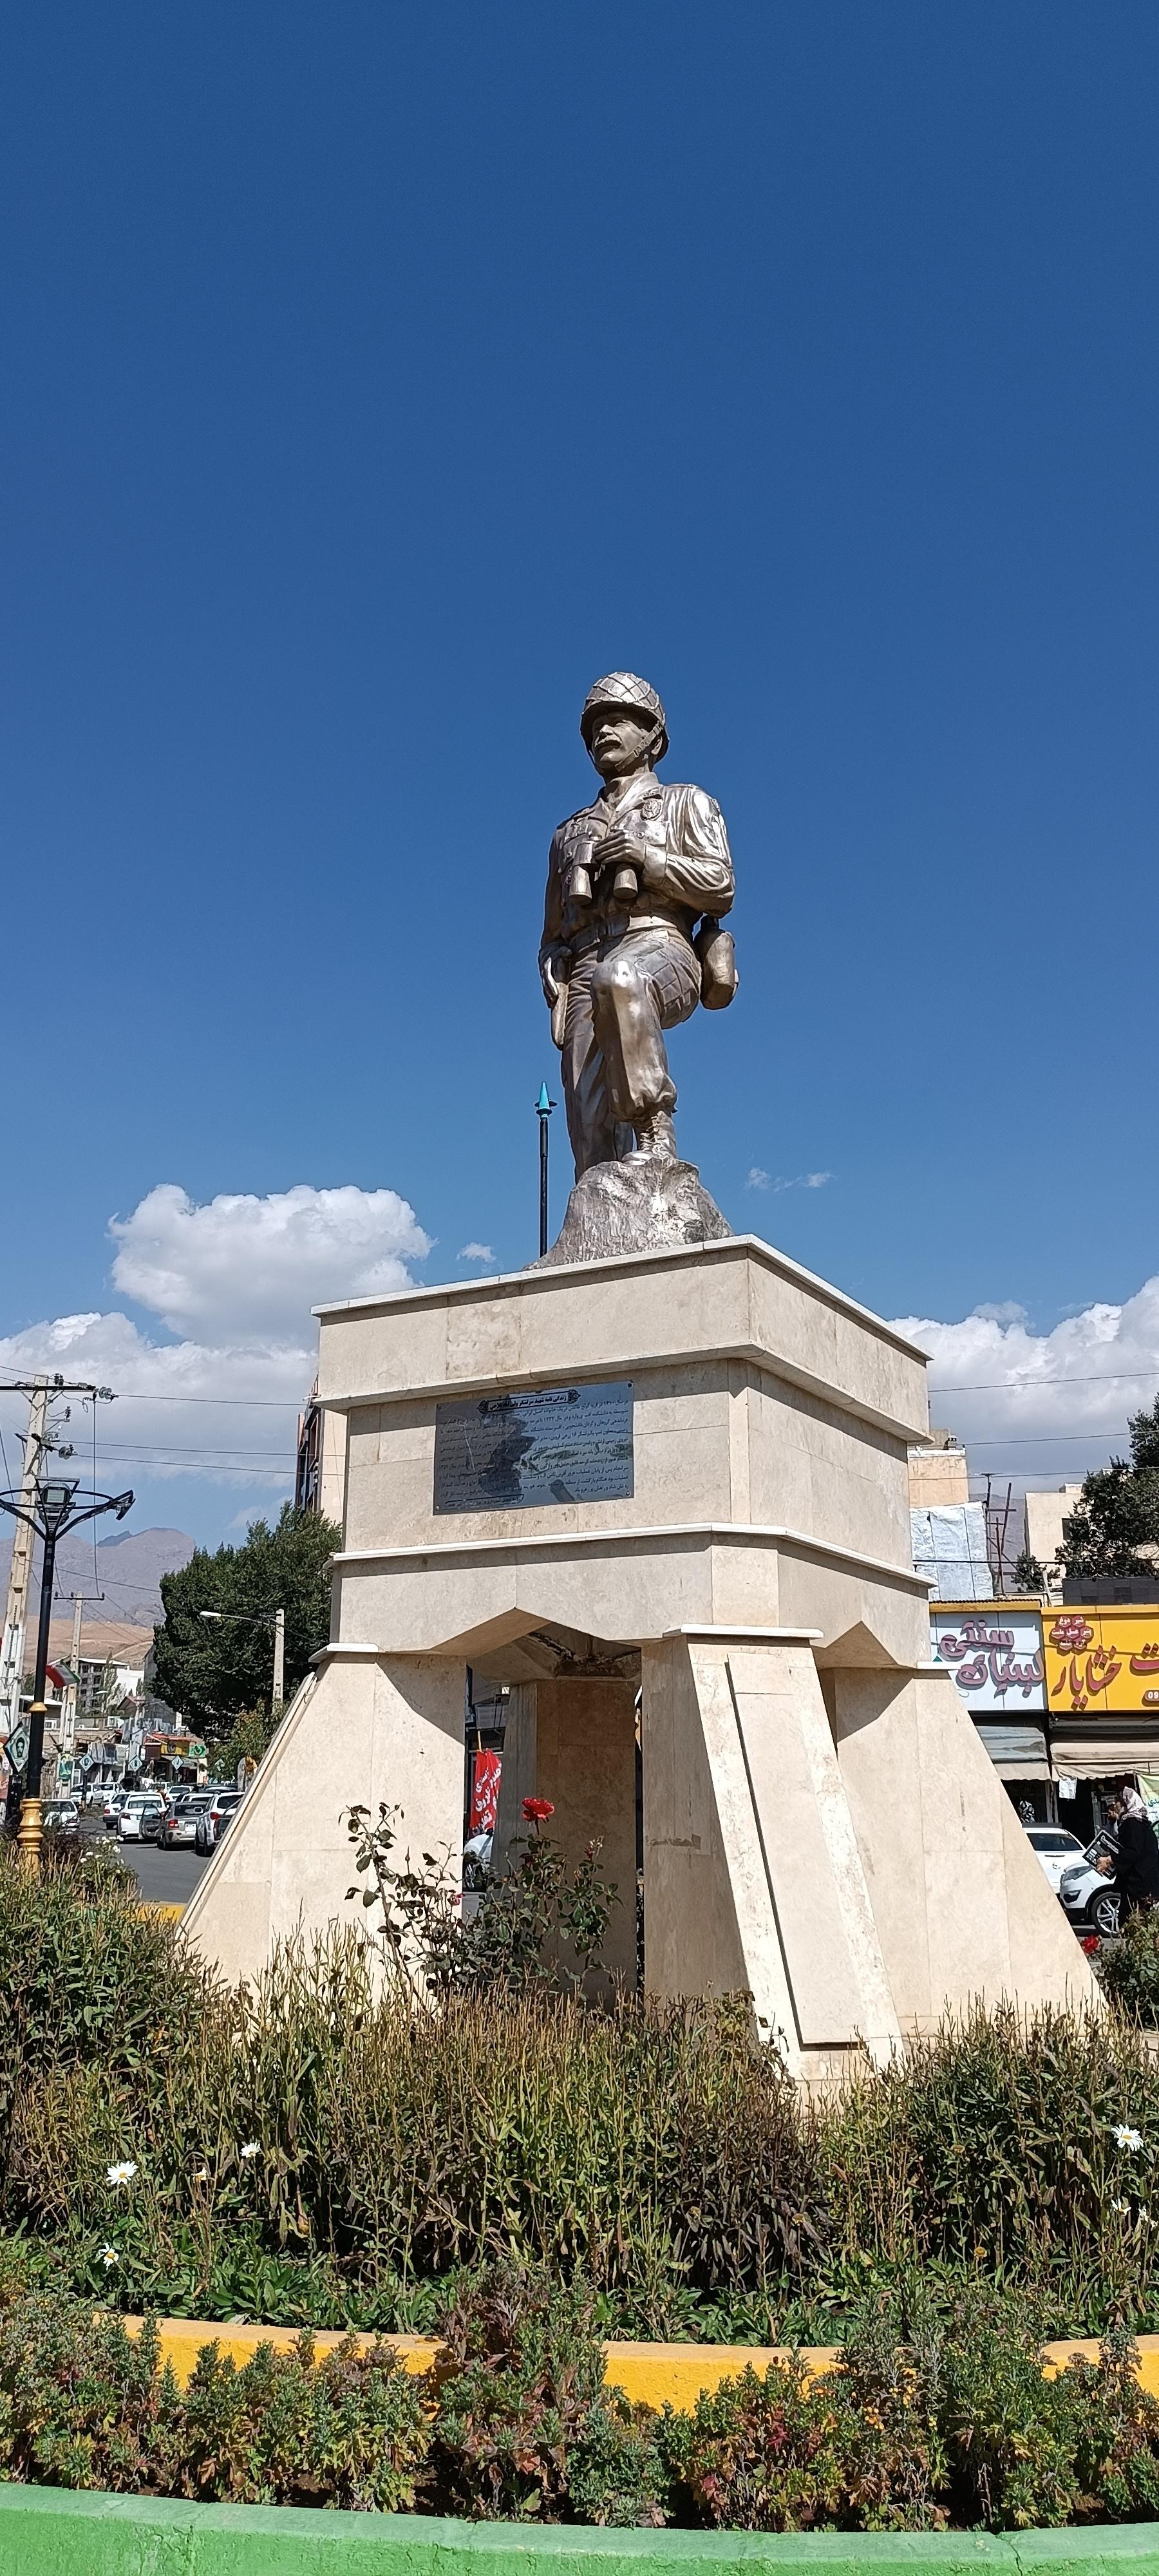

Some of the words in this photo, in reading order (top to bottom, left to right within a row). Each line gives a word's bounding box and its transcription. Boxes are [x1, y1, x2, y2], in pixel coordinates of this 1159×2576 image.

[939, 1619, 1015, 1660] سنتی
[1059, 1616, 1071, 1625] دوغ
[1066, 1627, 1079, 1636] عسل
[956, 1647, 1045, 1696] لبنیات
[1051, 1644, 1122, 1710] خشایار
